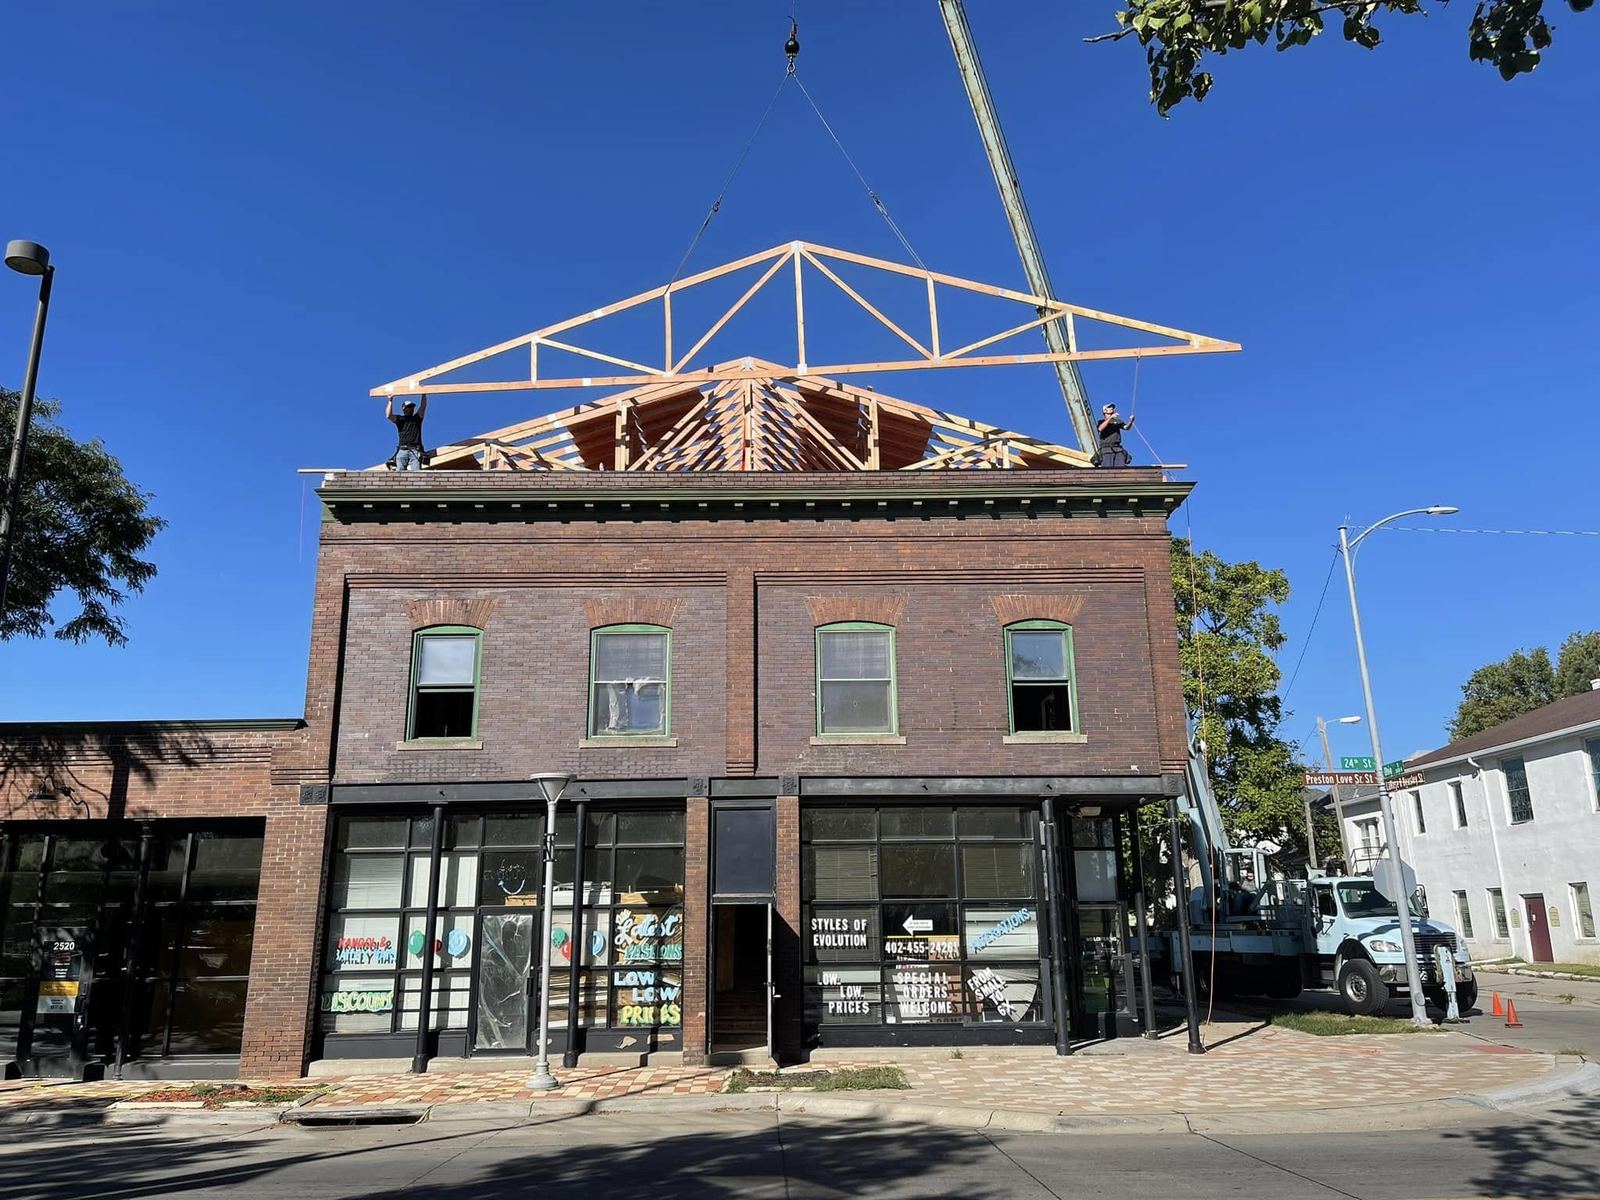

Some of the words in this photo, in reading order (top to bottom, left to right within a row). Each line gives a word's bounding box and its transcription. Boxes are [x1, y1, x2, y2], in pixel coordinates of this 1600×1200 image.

[1363, 758, 1372, 768] St
[1305, 774, 1334, 784] Preston
[1335, 774, 1353, 784] Love
[1364, 774, 1374, 784] St
[811, 918, 849, 931] STYLES
[853, 919, 867, 931] OF
[53, 941, 75, 951] 2520
[813, 934, 867, 947] EVOLUTION
[614, 971, 654, 987] LOW
[967, 967, 995, 991] FROM
[632, 987, 679, 1002] LOW
[903, 986, 948, 998] ORDERS
[974, 975, 1006, 1001] SMALL
[989, 991, 1004, 1006] TO
[900, 1001, 952, 1014] WELCOME
[997, 999, 1015, 1017] 6X
